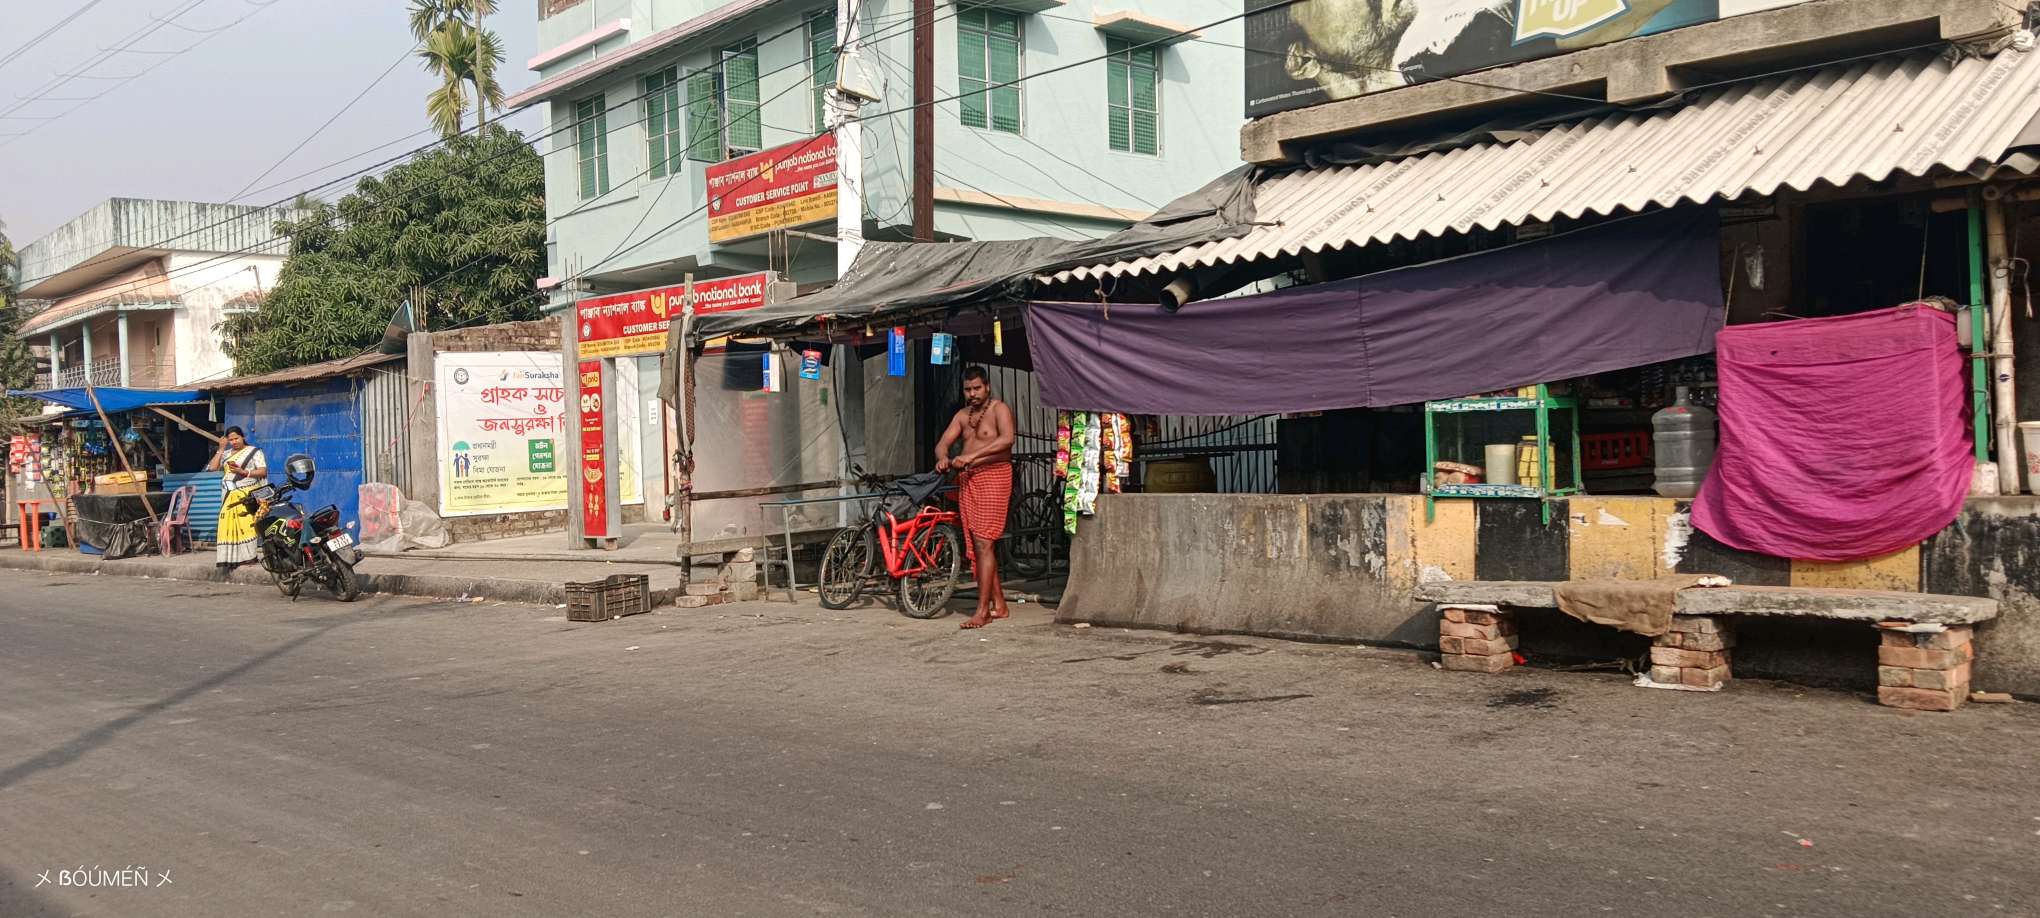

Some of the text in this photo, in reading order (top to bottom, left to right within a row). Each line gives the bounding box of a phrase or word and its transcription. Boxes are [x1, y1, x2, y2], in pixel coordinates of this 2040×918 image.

[775, 154, 798, 174] punjab
[798, 146, 827, 165] national
[736, 192, 766, 207] CUSTOMER
[766, 186, 790, 202] SERVICE
[791, 181, 809, 195] POINT
[669, 280, 762, 310] punb national bank
[623, 322, 658, 334] CUSTOMER
[481, 386, 528, 406] গ্রাহক
[534, 404, 547, 415] ও
[476, 415, 554, 436] জনসুরক্ষা
